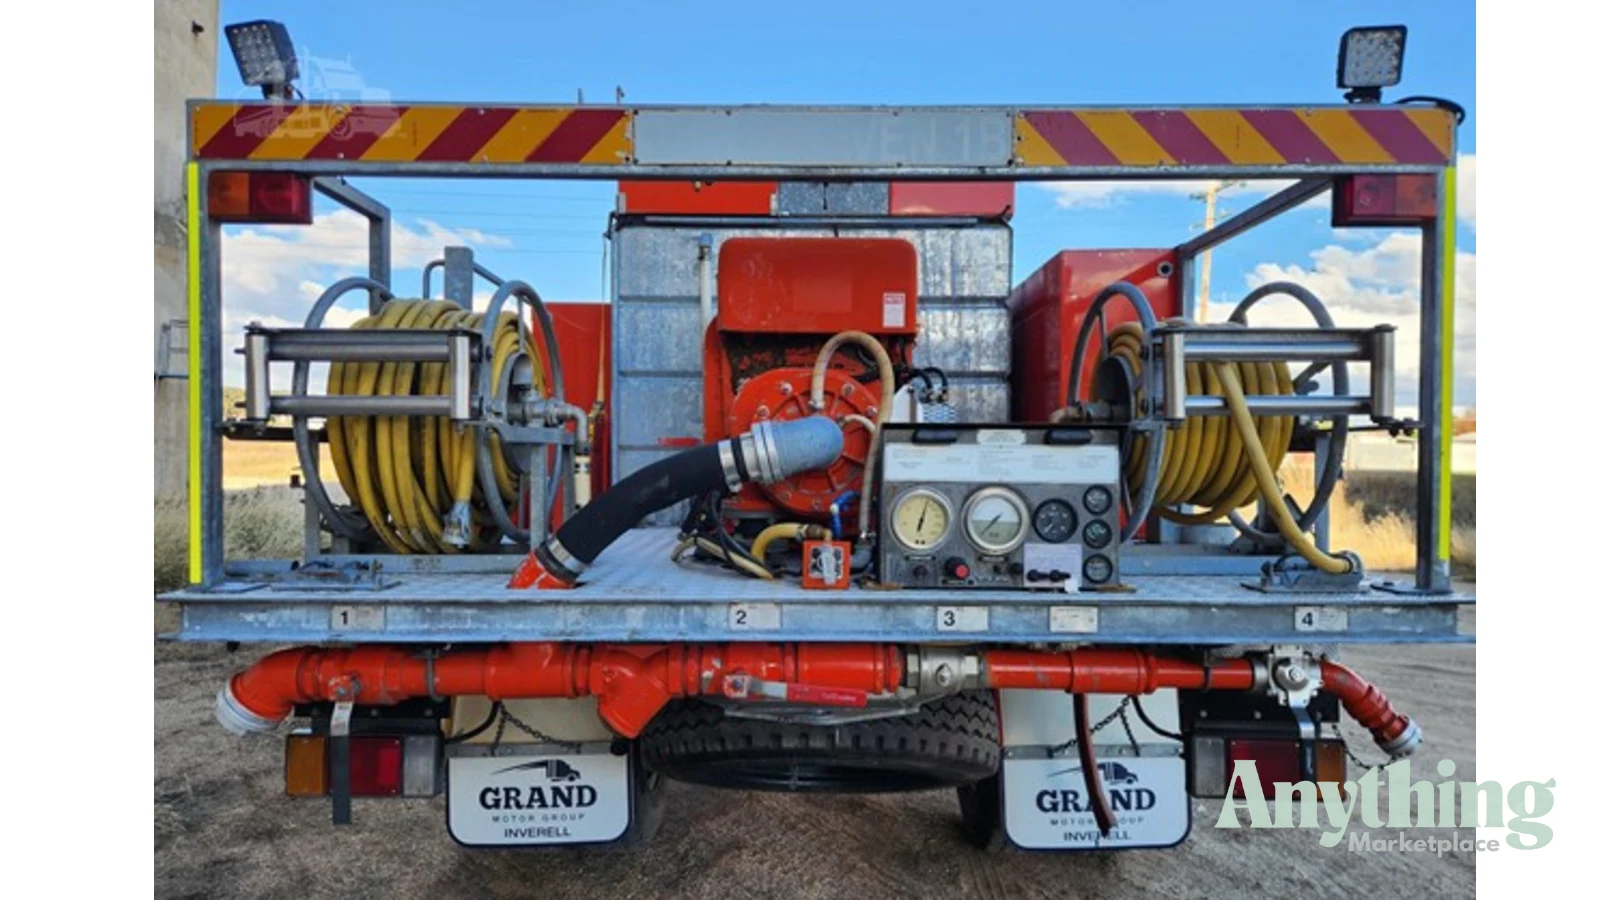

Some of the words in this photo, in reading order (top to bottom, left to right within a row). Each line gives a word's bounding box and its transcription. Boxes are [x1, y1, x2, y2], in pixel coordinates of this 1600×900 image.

[341, 611, 348, 625] 1
[736, 609, 747, 625] 2
[943, 610, 956, 627] 3
[1302, 612, 1313, 626] 4
[479, 785, 597, 810] GRAND
[491, 814, 536, 823] MOTOR
[541, 813, 586, 823] GROUP
[504, 827, 571, 838] INVERELL
[1064, 830, 1131, 841] INVEELL
